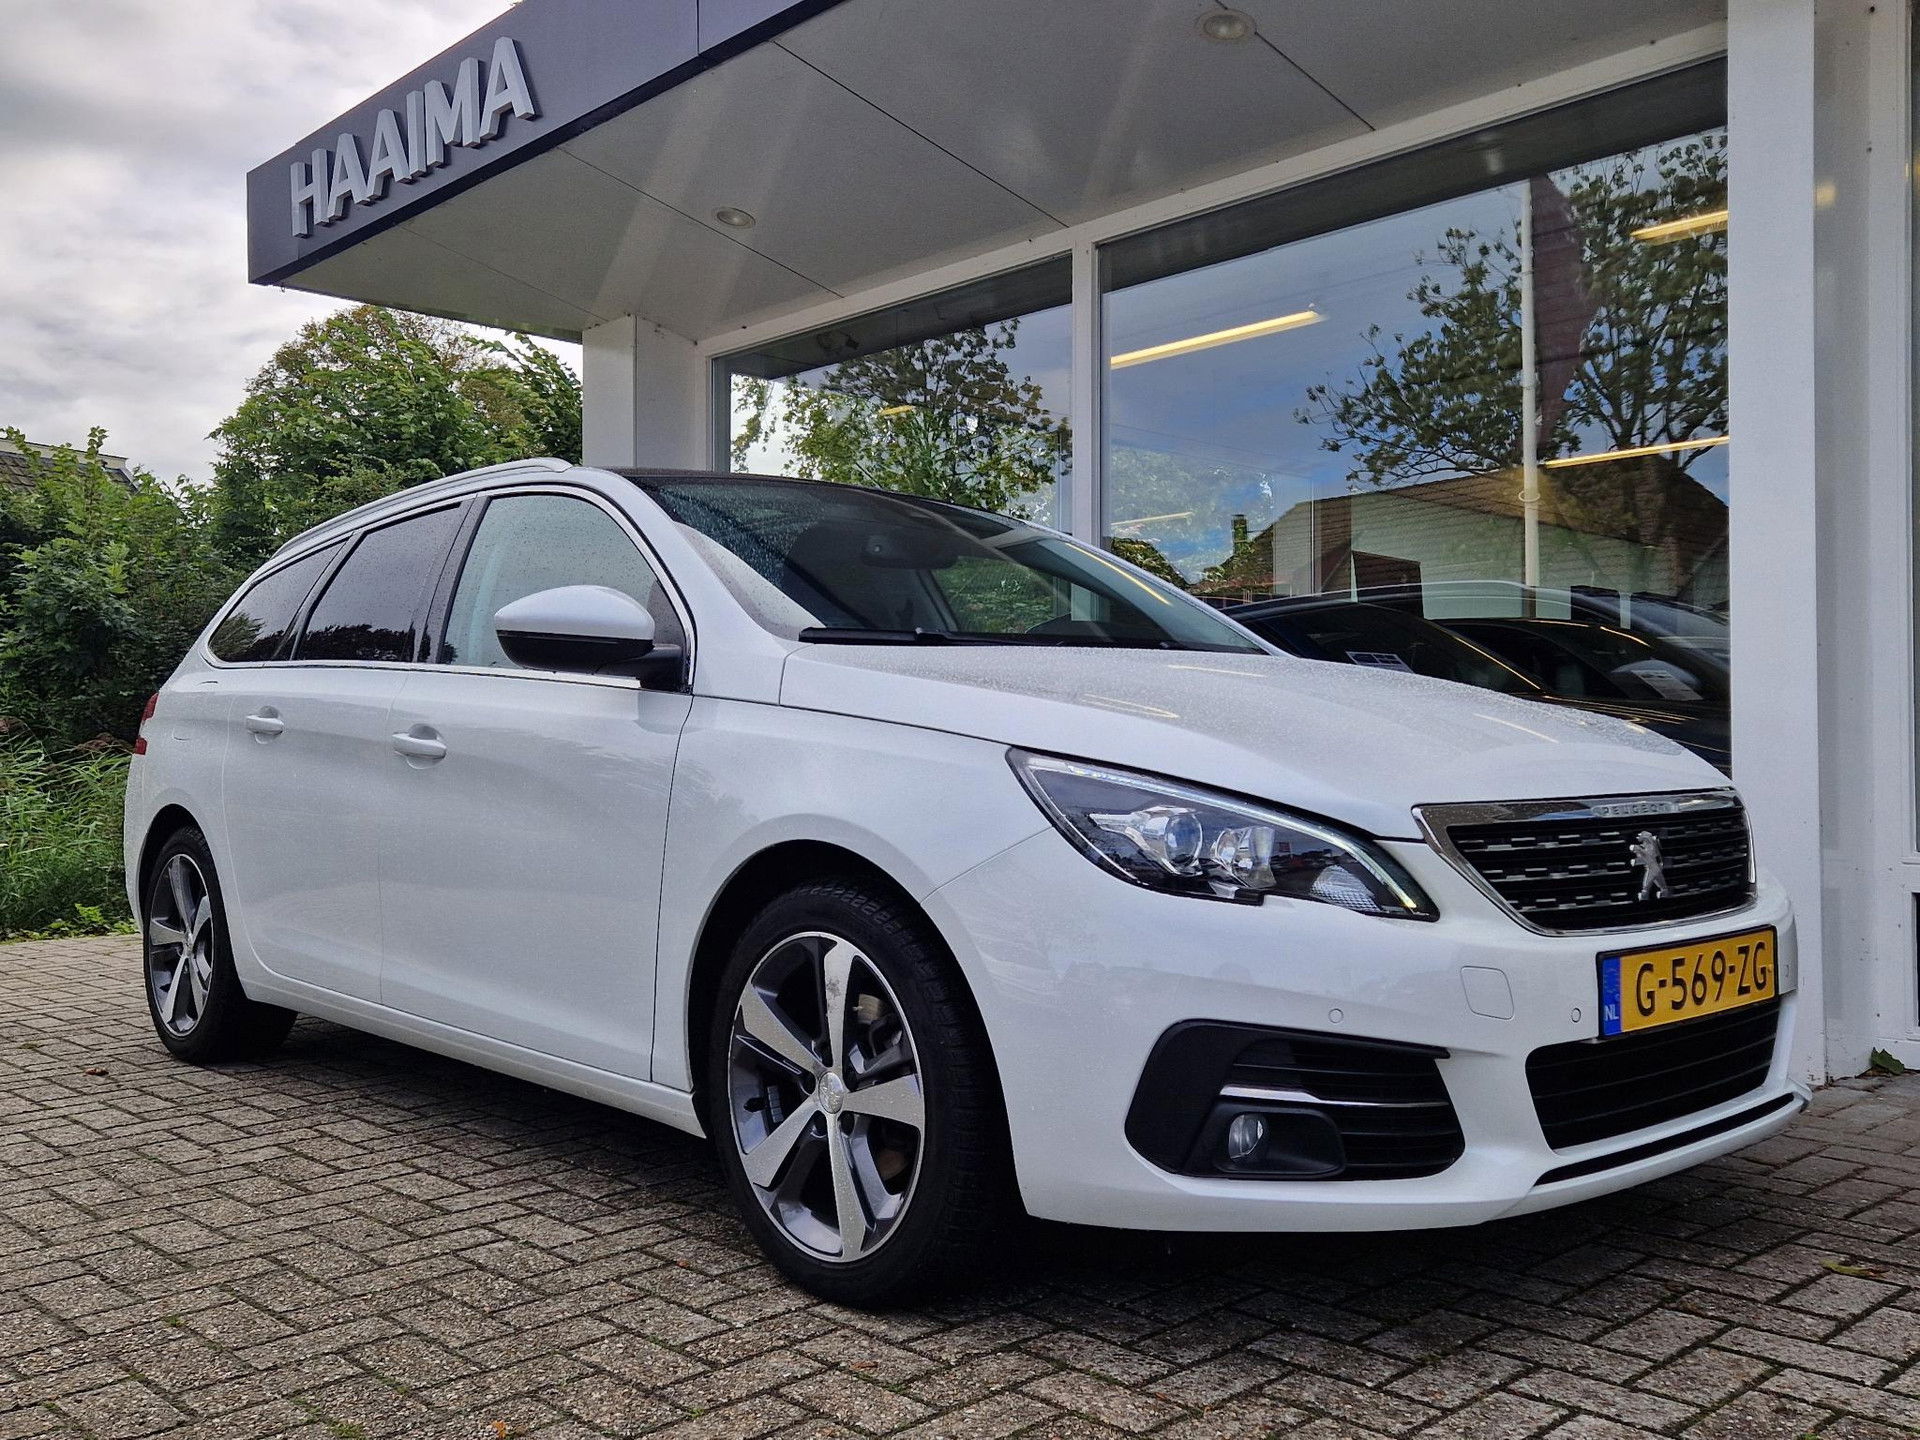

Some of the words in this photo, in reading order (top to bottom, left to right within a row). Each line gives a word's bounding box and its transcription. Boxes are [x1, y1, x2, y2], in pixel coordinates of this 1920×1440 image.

[290, 36, 536, 238] HAAIMA
[1602, 803, 1664, 816] PEUGEOT
[1636, 941, 1768, 1017] G-569-ZG
[1604, 1004, 1619, 1021] NL
